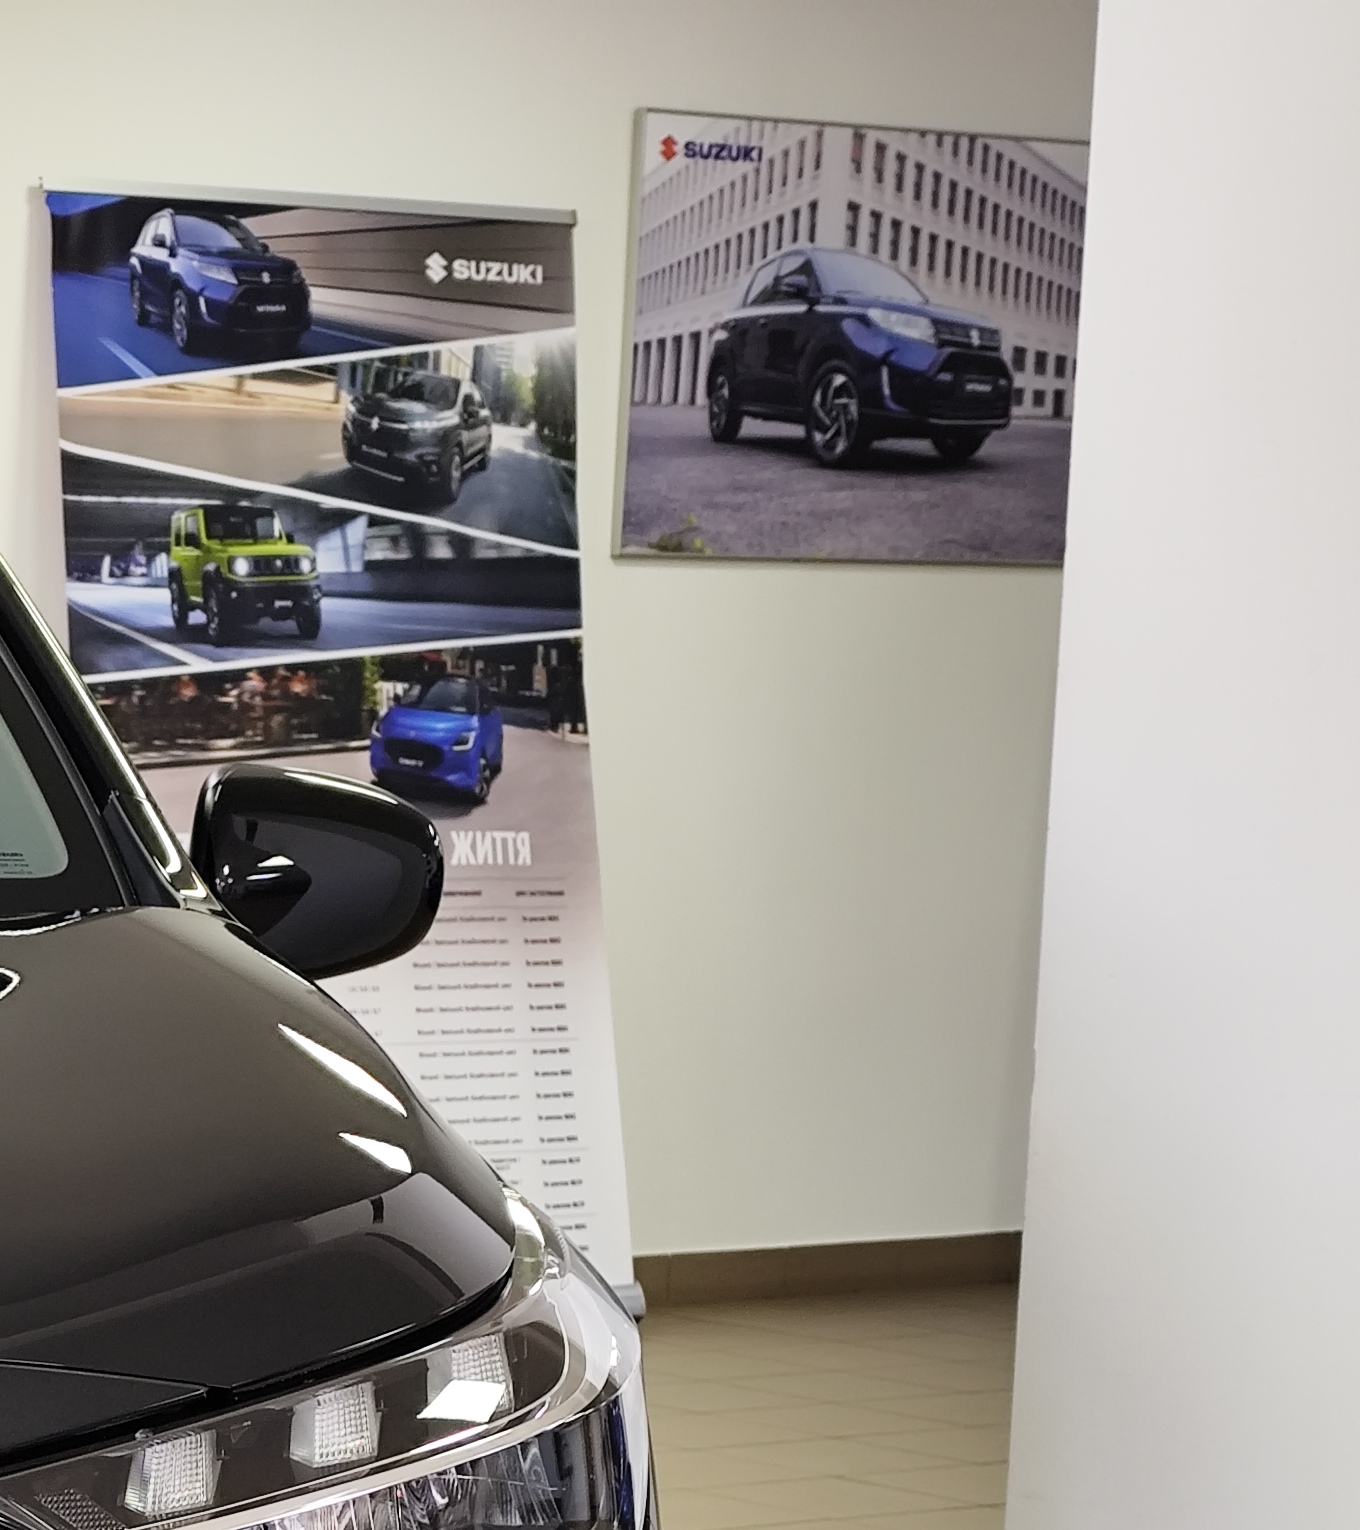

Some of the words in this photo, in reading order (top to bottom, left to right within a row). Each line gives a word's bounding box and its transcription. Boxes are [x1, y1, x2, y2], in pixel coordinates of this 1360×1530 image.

[684, 141, 763, 163] SUZUKI
[451, 258, 544, 285] SUZUKI
[450, 830, 532, 866] ЖИТТЯ
